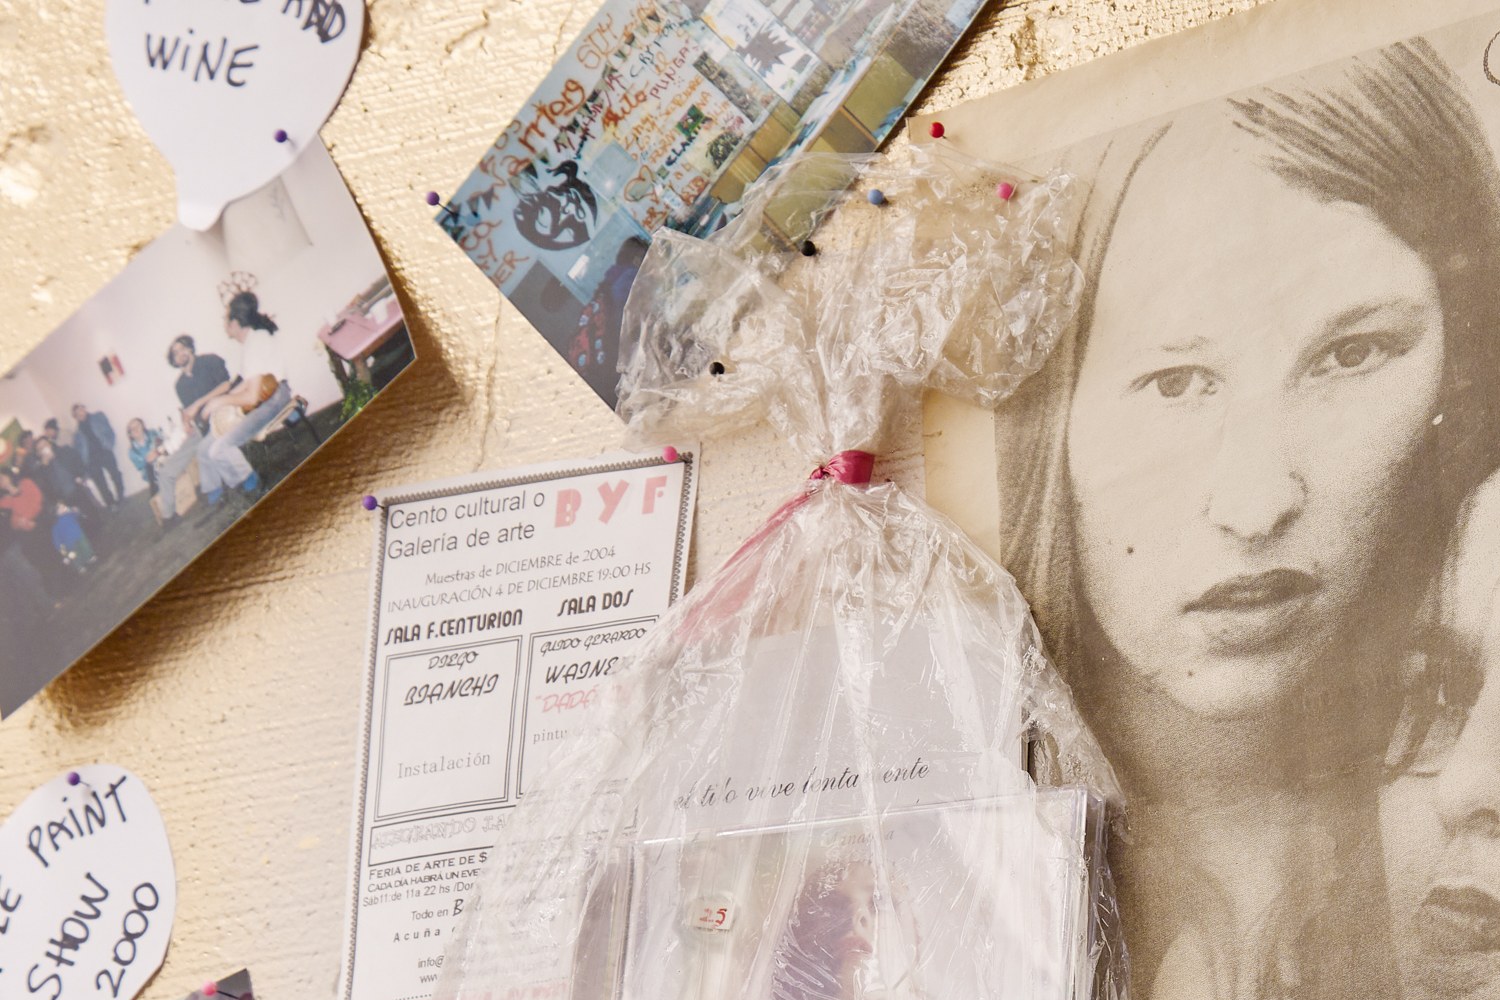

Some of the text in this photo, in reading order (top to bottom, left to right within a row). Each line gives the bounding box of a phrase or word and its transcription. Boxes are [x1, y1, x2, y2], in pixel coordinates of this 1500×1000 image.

[389, 490, 545, 529] Cento cultural o
[387, 521, 535, 560] Galería de arte
[425, 546, 616, 586] Muestras de DICIEMBRE de 2004
[387, 561, 651, 612] INAUGURACIÓN 4 DE DICIEMBRE 19:00 HS
[557, 589, 634, 618] SALA DOS
[384, 621, 421, 646] SALA
[540, 627, 648, 657] GUIDO GERARDO
[427, 650, 479, 671] DIEGO
[545, 656, 622, 684] WAINE
[397, 751, 491, 779] Instalación
[802, 756, 930, 794] lentaente
[367, 881, 393, 893] CADA
[445, 870, 460, 881] UN
[369, 867, 402, 881] FERIA
[405, 863, 421, 873] DE
[424, 857, 456, 871] ARTE
[459, 854, 476, 865] DE
[411, 909, 434, 921] Todo
[436, 908, 449, 917] en
[96, 882, 159, 998] 2000
[393, 927, 441, 943] Acuña
